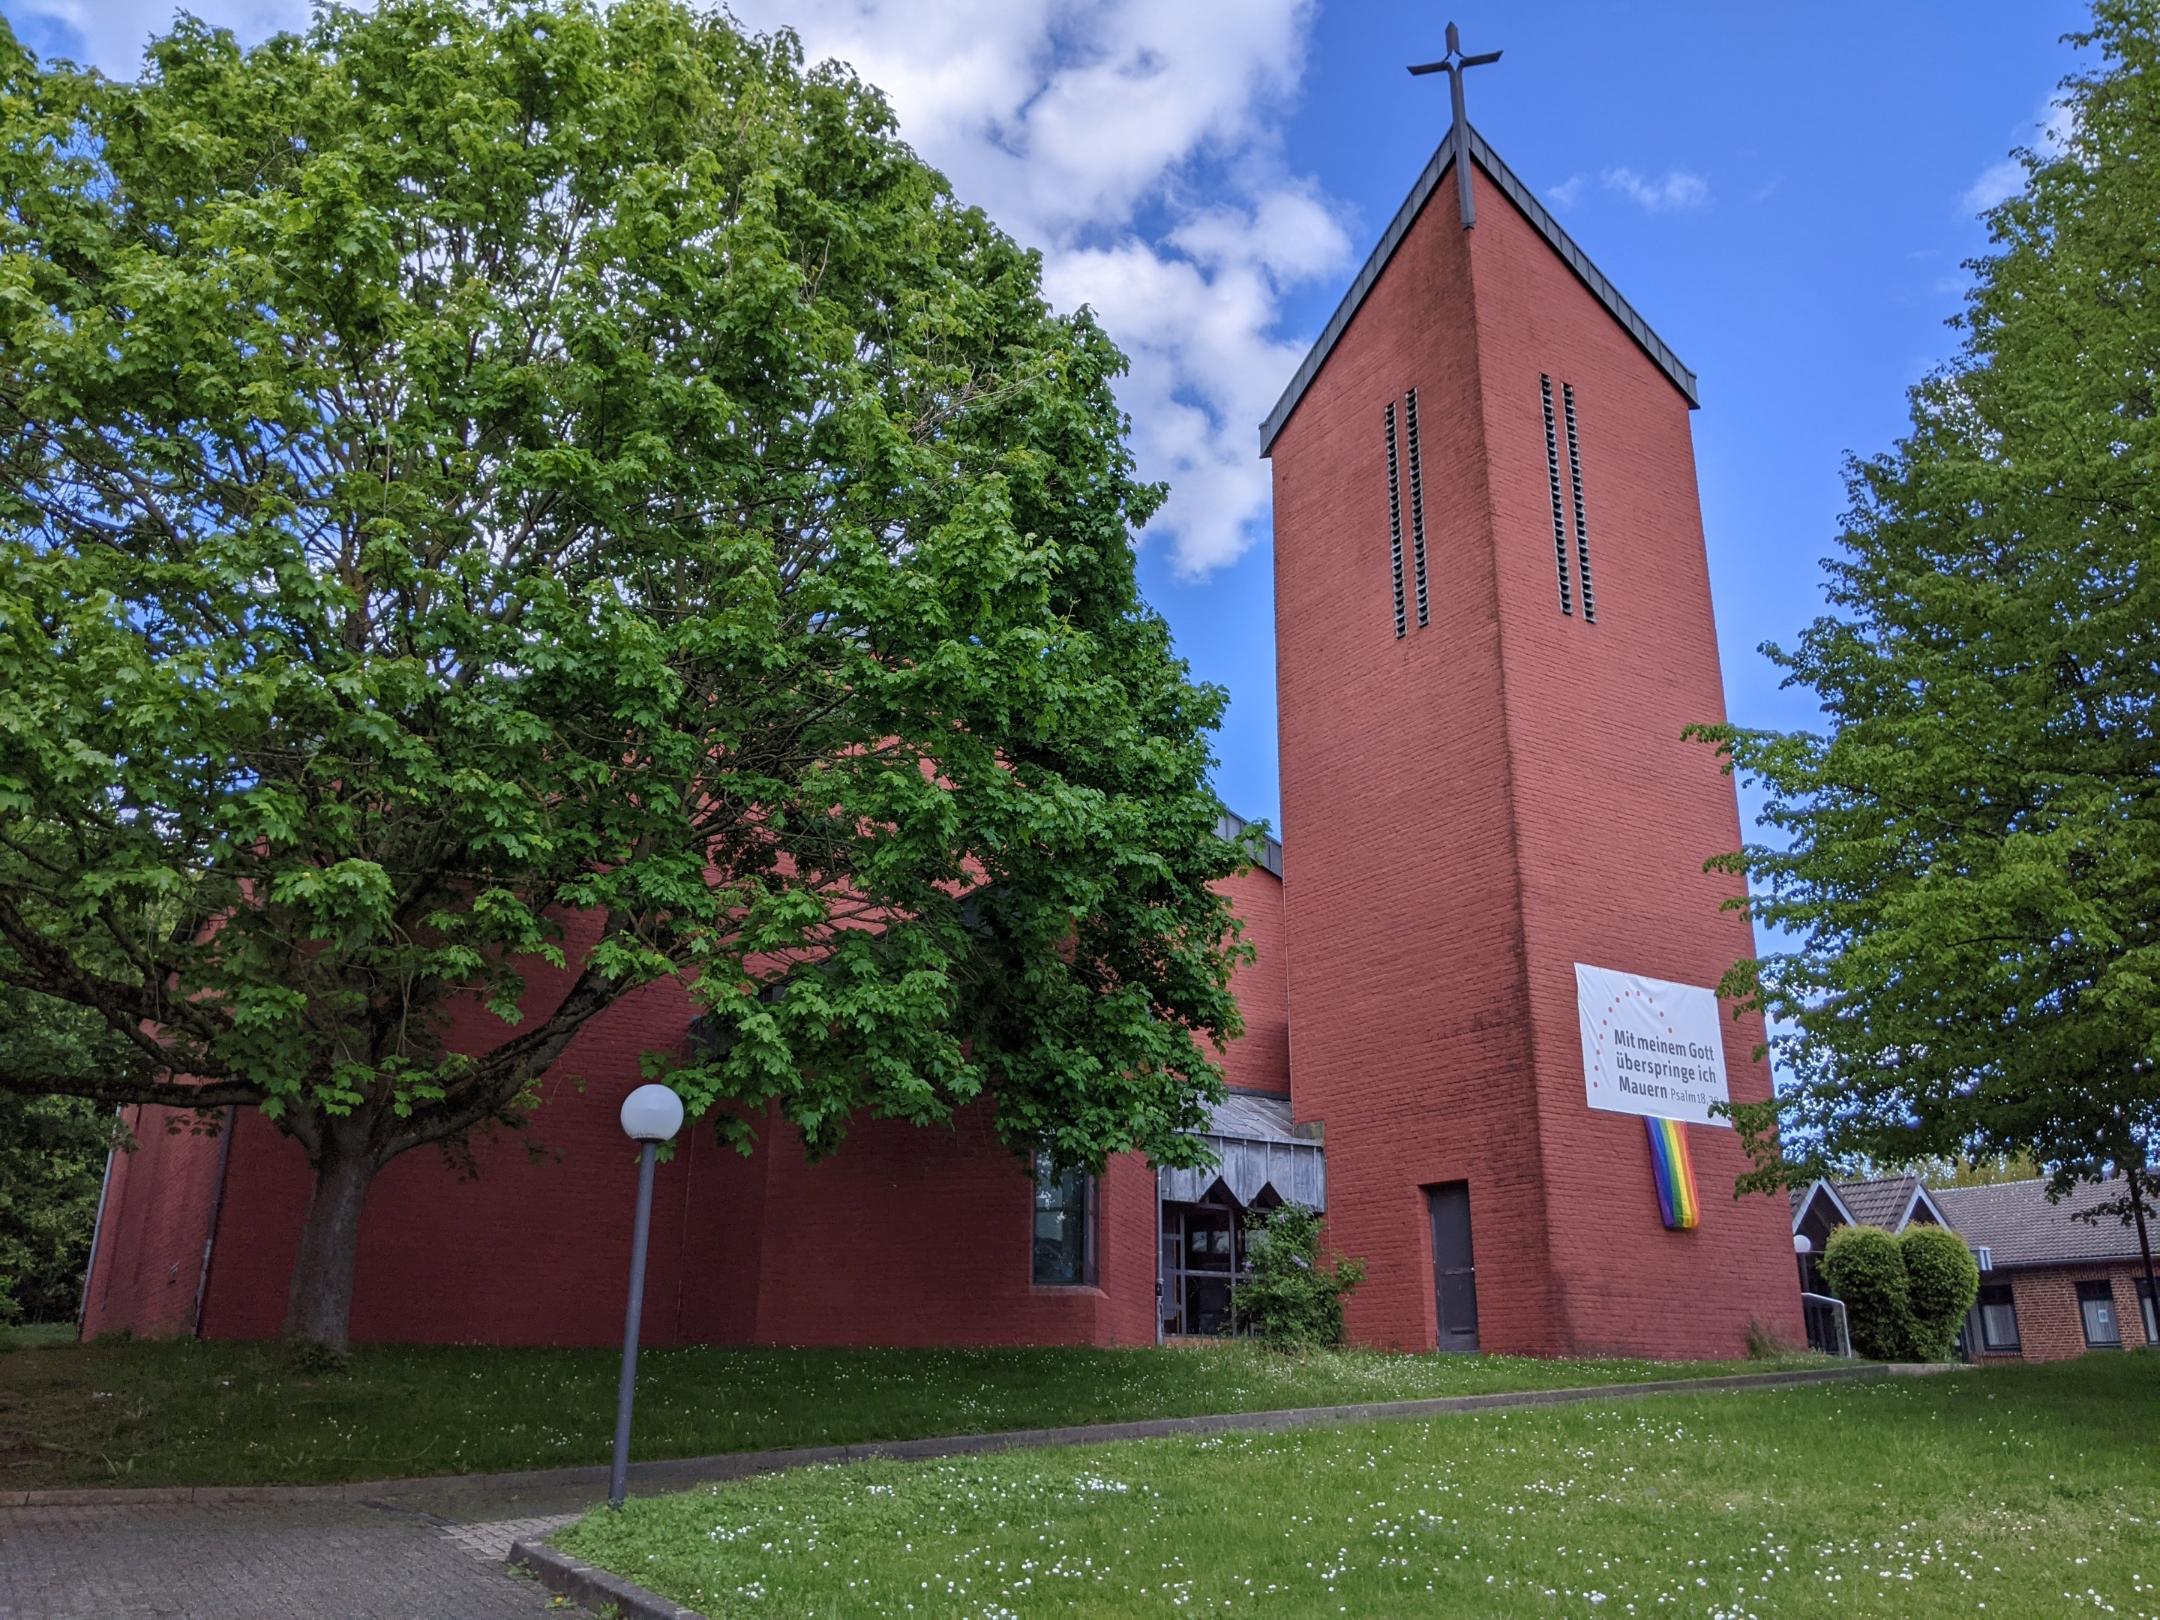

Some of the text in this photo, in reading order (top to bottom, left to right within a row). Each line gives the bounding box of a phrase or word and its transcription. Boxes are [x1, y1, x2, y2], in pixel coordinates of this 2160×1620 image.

[1614, 1029, 1715, 1061] Mit meinem Gott
[1617, 1051, 1717, 1083] überspringe ich
[1619, 1075, 1668, 1098] Mauern
[1670, 1088, 1697, 1103] Psalm
